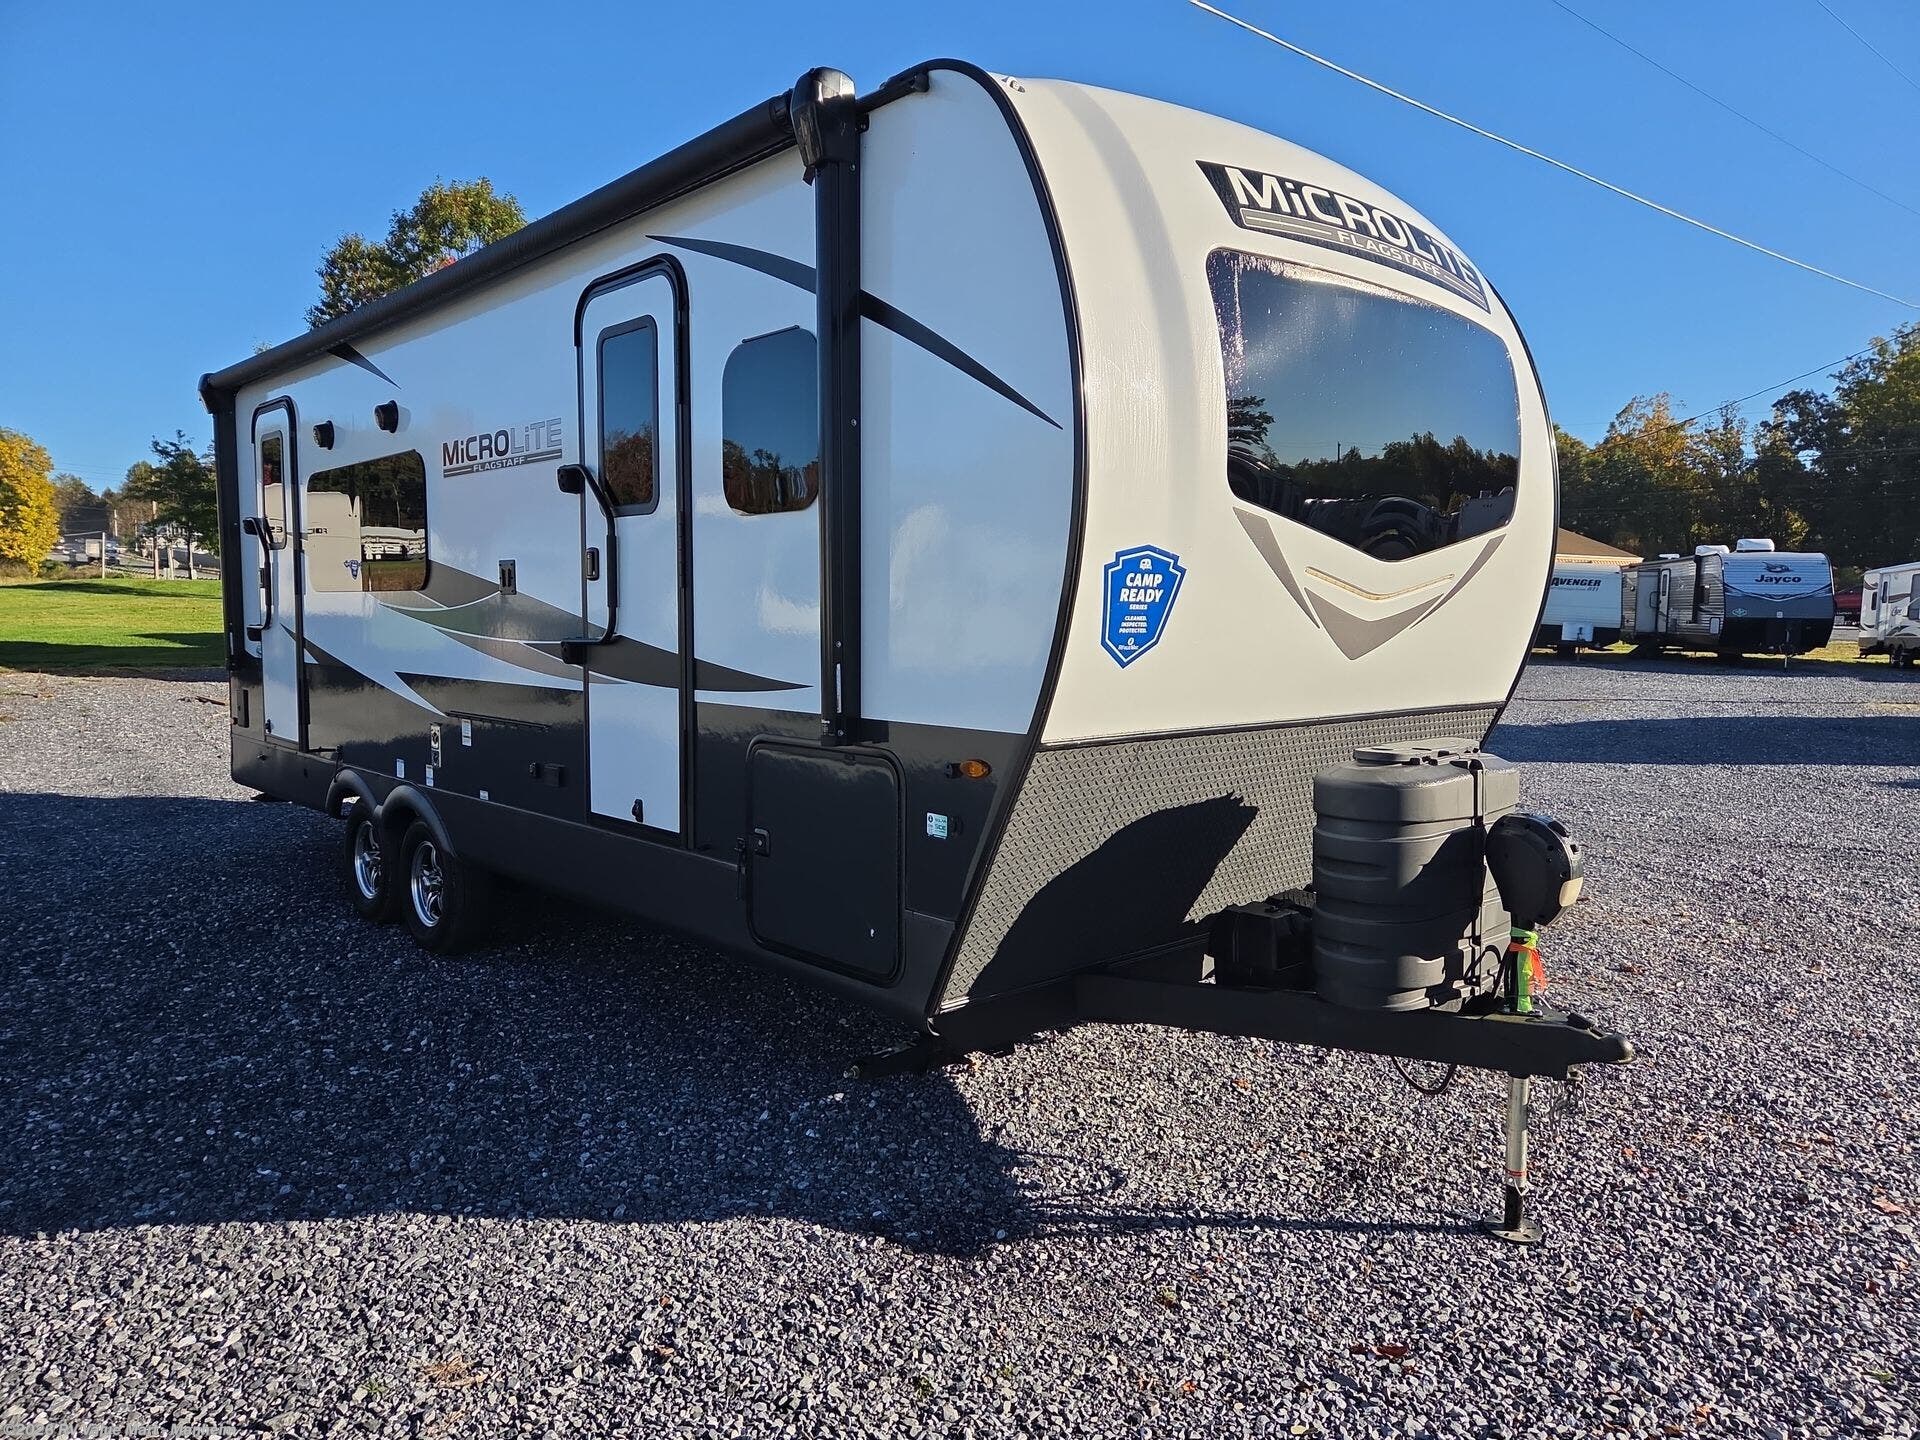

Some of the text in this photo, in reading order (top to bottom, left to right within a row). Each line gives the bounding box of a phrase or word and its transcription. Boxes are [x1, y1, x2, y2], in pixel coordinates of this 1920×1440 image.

[1338, 231, 1442, 277] FLAGSTAFF
[473, 456, 525, 472] FLAGSTAFF
[1126, 573, 1163, 587] CAMP
[1551, 577, 1602, 587] AVENGER
[1754, 575, 1802, 585] Jayco
[1120, 588, 1164, 603] READY
